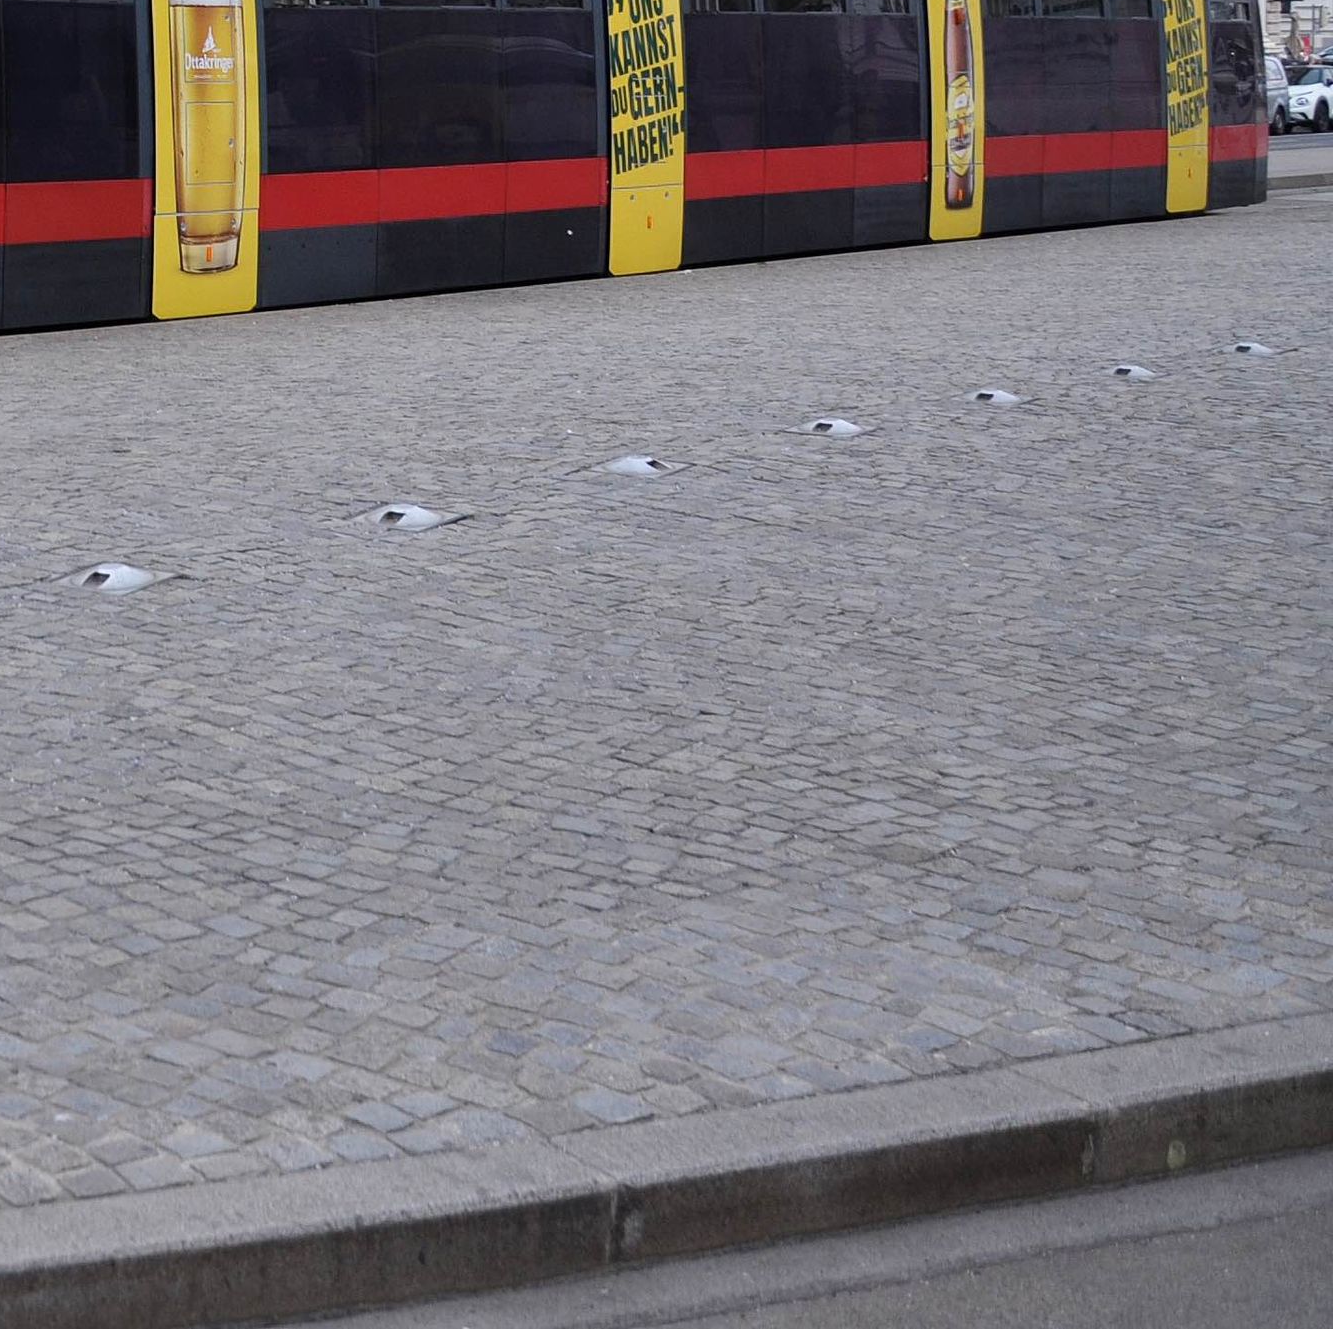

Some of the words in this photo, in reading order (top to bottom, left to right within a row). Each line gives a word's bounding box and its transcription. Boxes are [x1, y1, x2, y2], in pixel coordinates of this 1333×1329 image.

[610, 14, 677, 78] KANNST
[1167, 17, 1203, 64] KANNST
[612, 84, 627, 118] DU
[628, 62, 684, 121] GERN-
